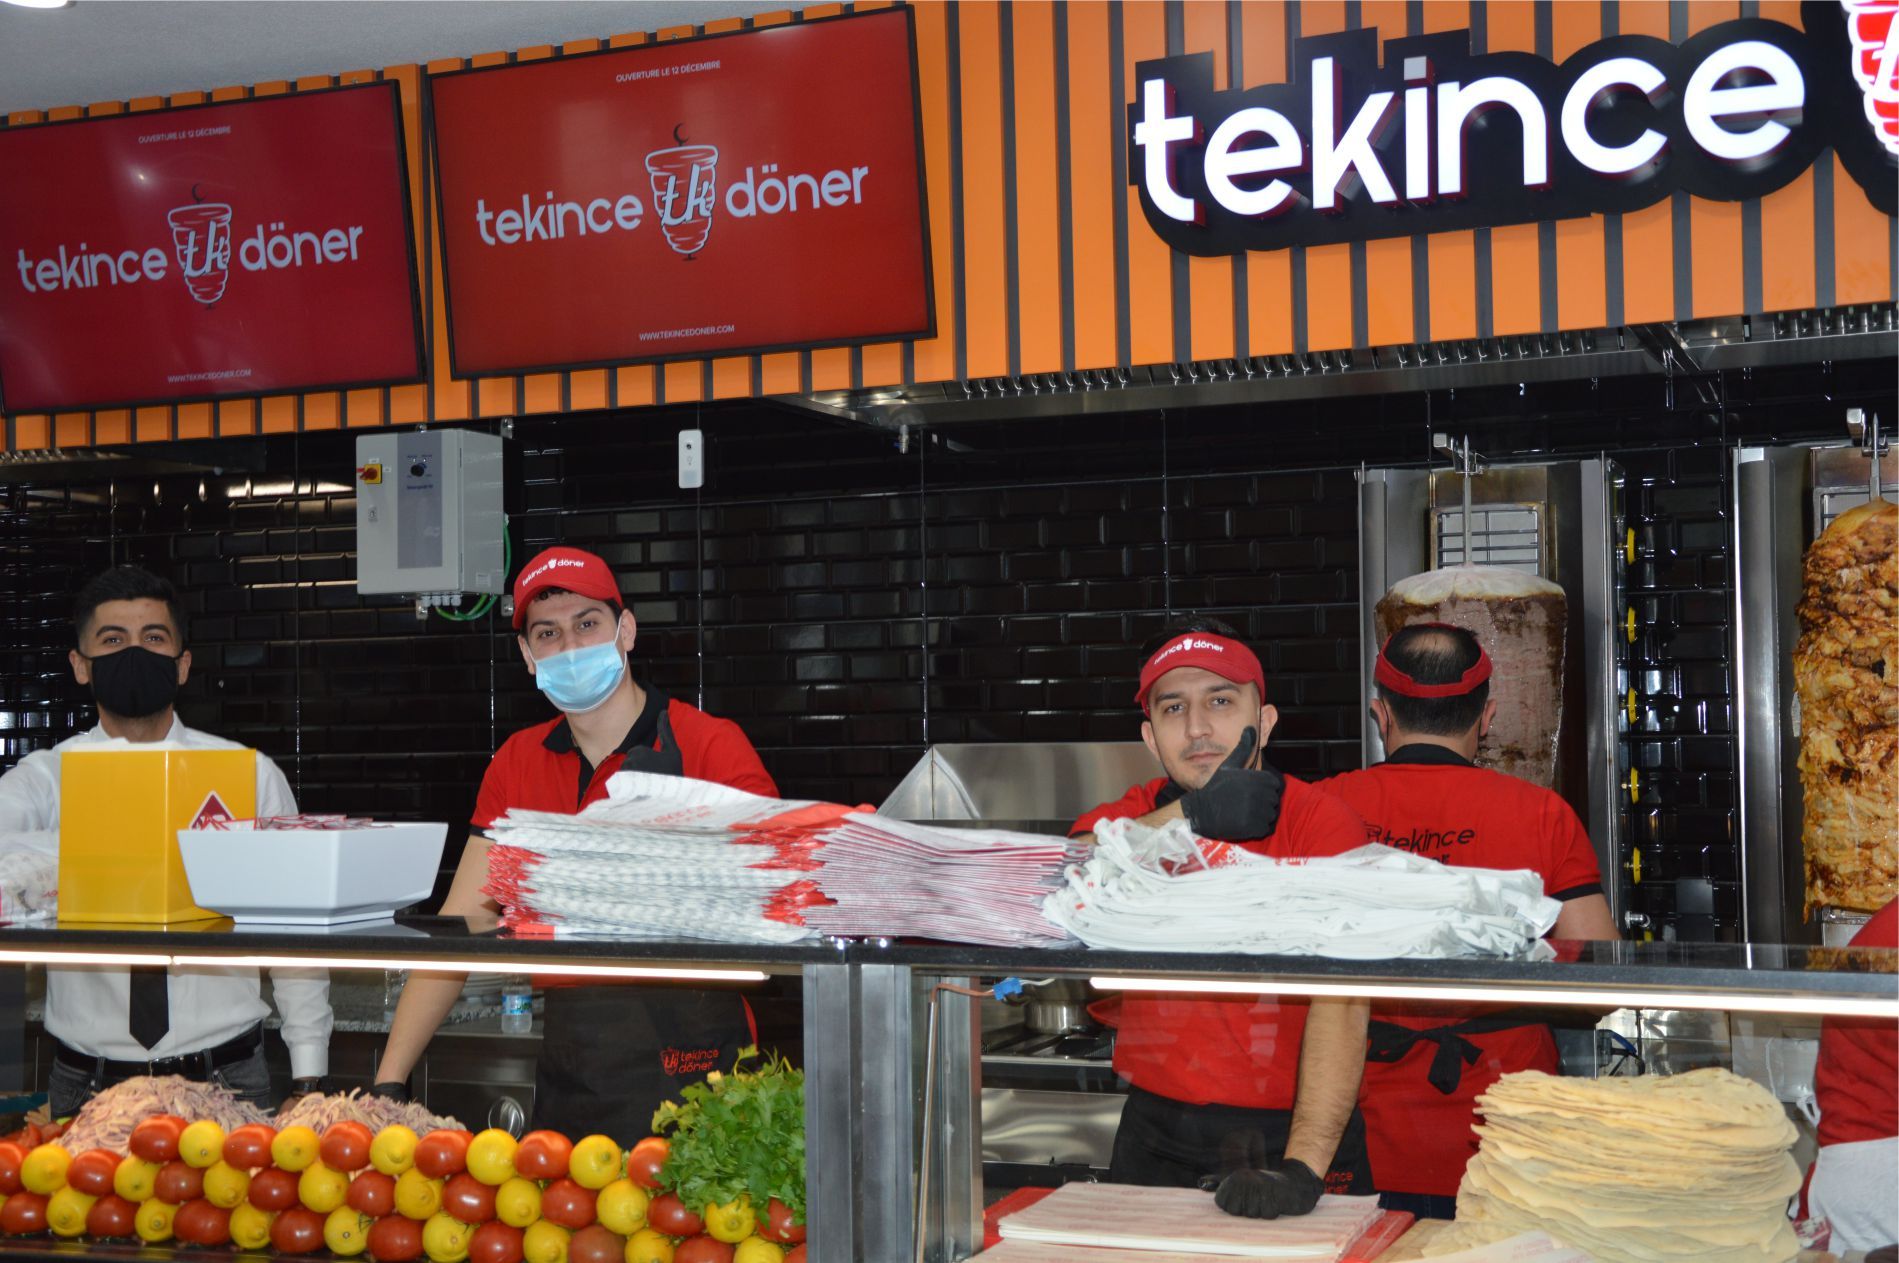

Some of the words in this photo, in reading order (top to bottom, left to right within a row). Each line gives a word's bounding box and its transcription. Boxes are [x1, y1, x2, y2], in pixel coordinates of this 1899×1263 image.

[615, 69, 660, 83] OUVERTURE
[661, 67, 670, 77] LE
[672, 66, 679, 75] 12
[681, 60, 721, 74] DÉCEMBRE
[1133, 40, 1806, 223] tekince
[476, 190, 645, 246] tekince
[725, 163, 869, 219] döner
[17, 242, 168, 293] tekince
[239, 221, 363, 272] döner
[638, 324, 735, 342] WWW.TEKINCEDONER.COM
[557, 558, 585, 569] döner
[1193, 640, 1224, 653] döner
[1383, 828, 1476, 854] tekince
